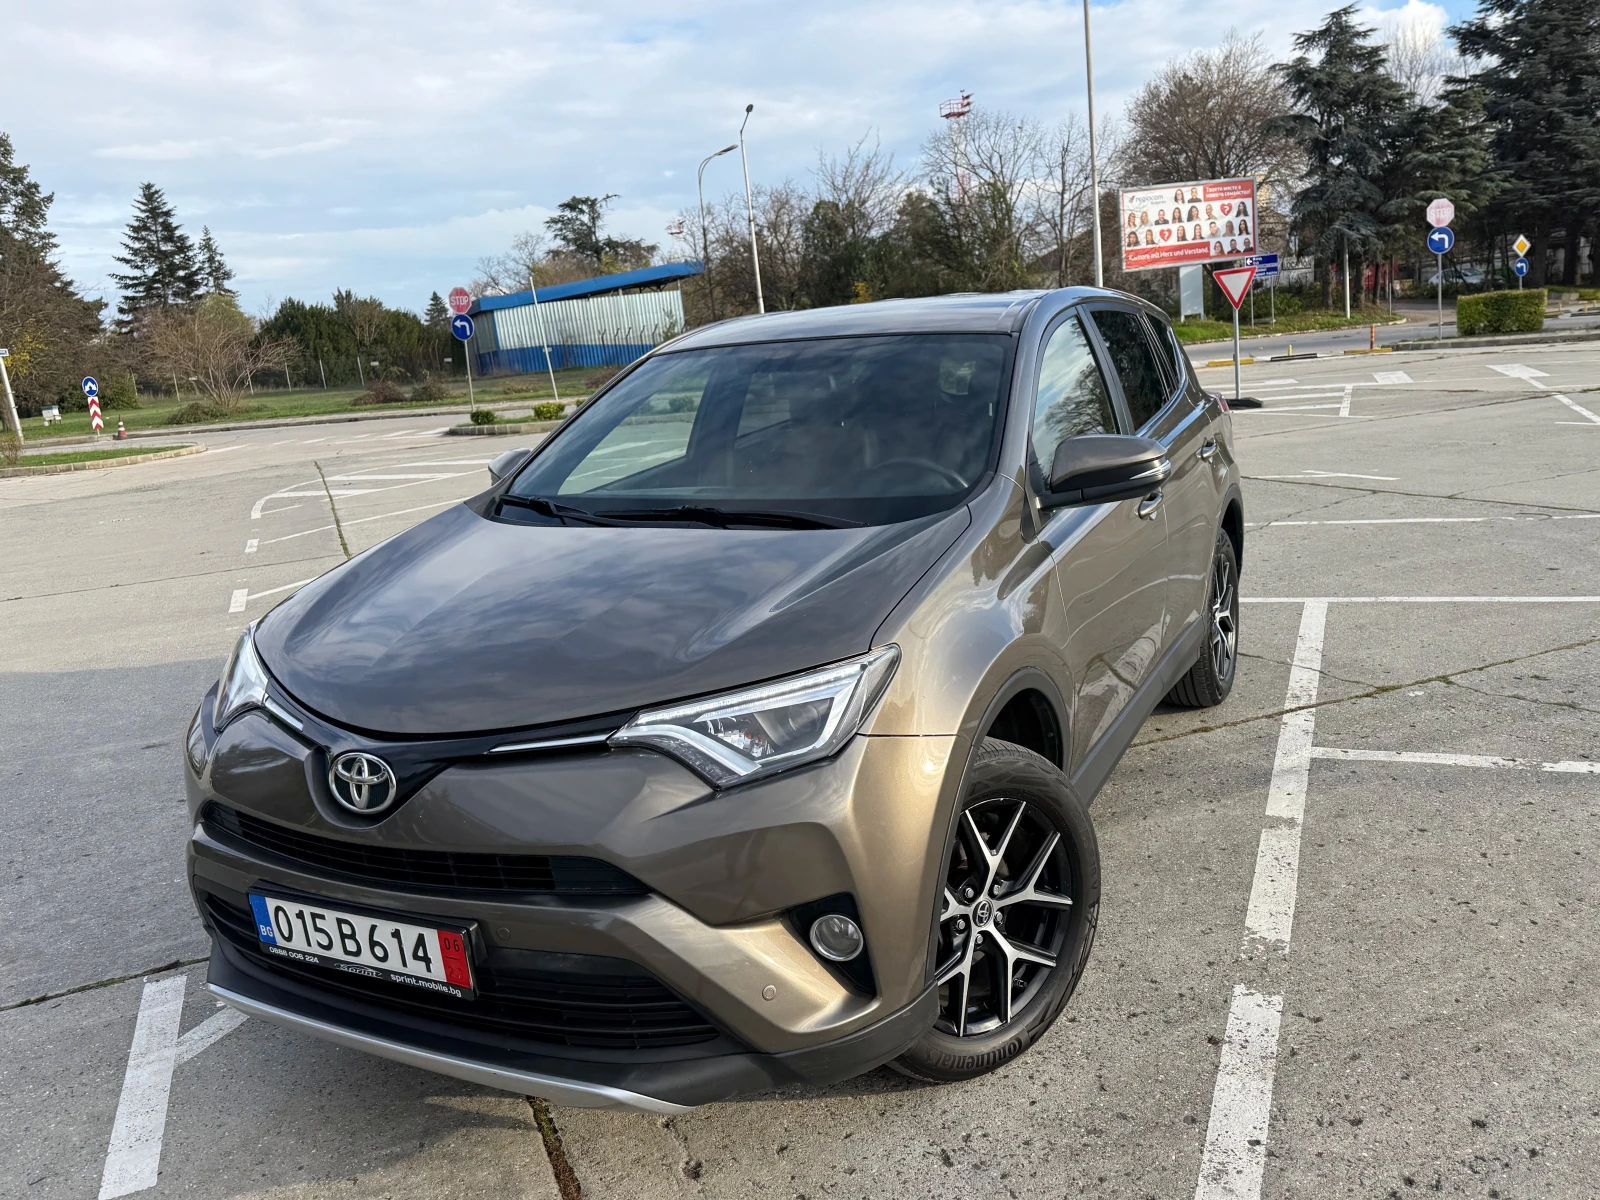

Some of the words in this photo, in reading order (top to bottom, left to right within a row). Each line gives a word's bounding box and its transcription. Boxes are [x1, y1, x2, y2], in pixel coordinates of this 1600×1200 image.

[1429, 207, 1452, 219] STOP
[450, 296, 469, 306] STOP
[260, 924, 274, 938] BG
[443, 937, 460, 953] 06
[304, 954, 320, 964] 224
[340, 963, 380, 978] Sprint
[390, 973, 462, 998] sprint.mobile.bg
[936, 1036, 1023, 1070] Continental
